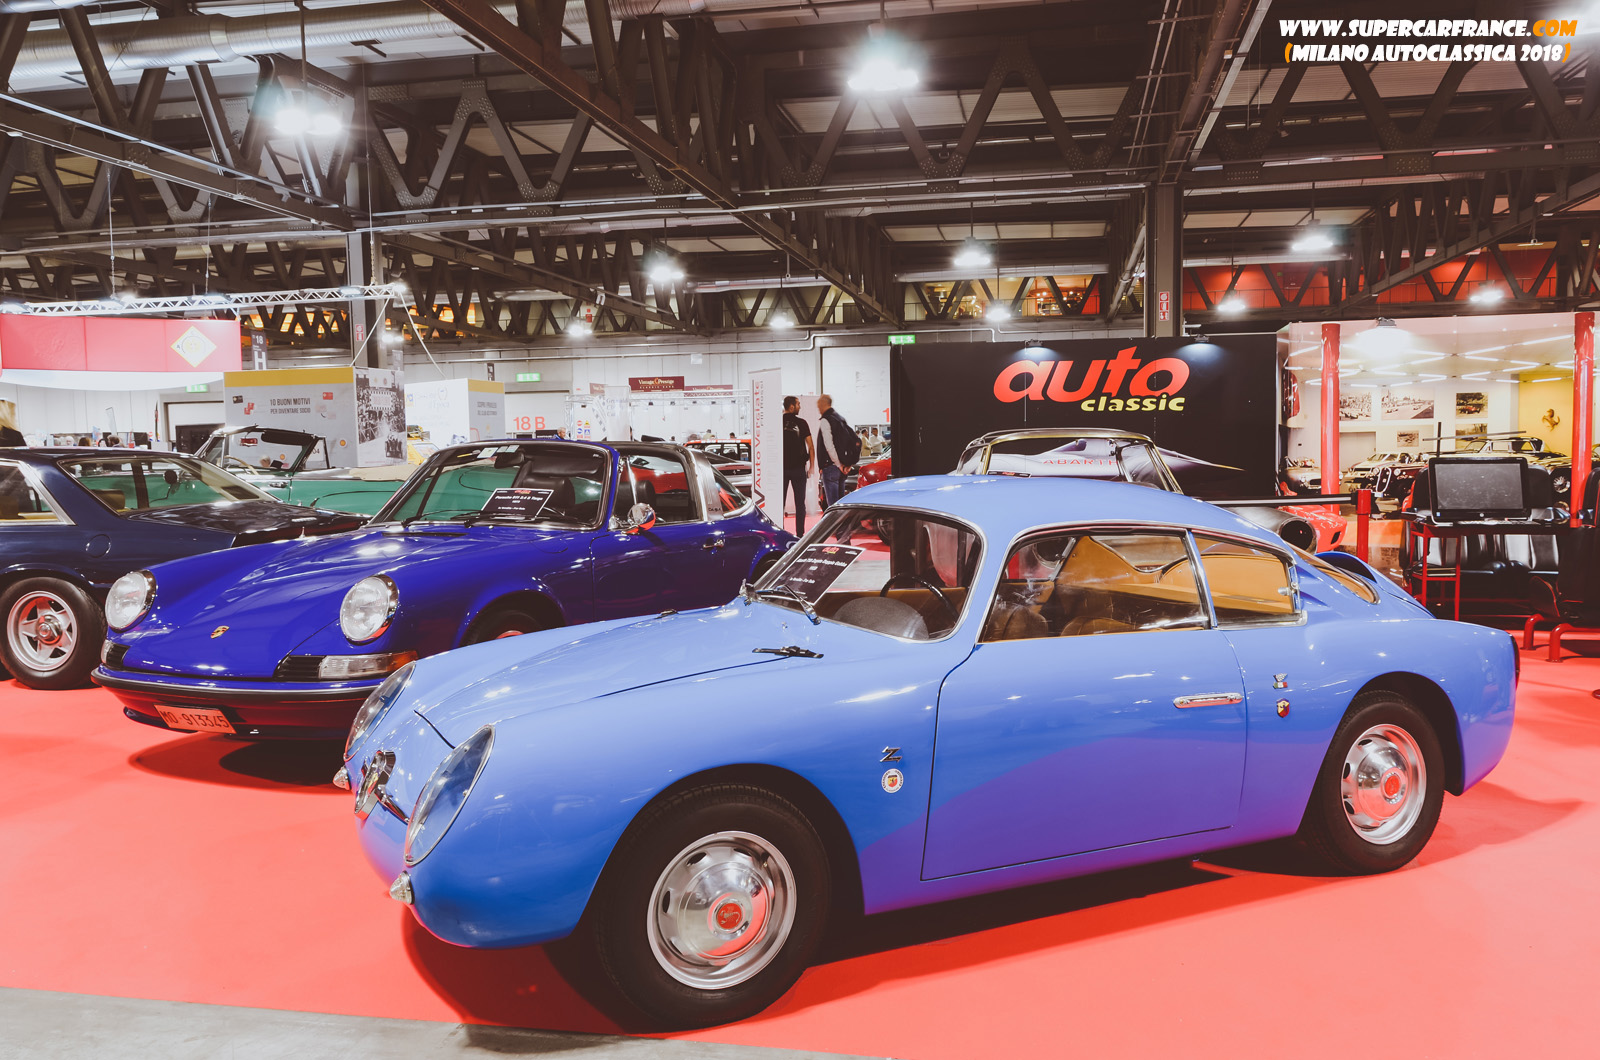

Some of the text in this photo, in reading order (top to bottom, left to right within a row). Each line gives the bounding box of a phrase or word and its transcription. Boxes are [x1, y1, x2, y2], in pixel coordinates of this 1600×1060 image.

[254, 350, 267, 370] H
[993, 345, 1190, 403] auto
[277, 398, 292, 406] BUONI
[293, 397, 311, 405] MOTIVI
[1080, 393, 1186, 412] classic
[513, 416, 546, 431] 18 B
[159, 710, 230, 728] MO 913345
